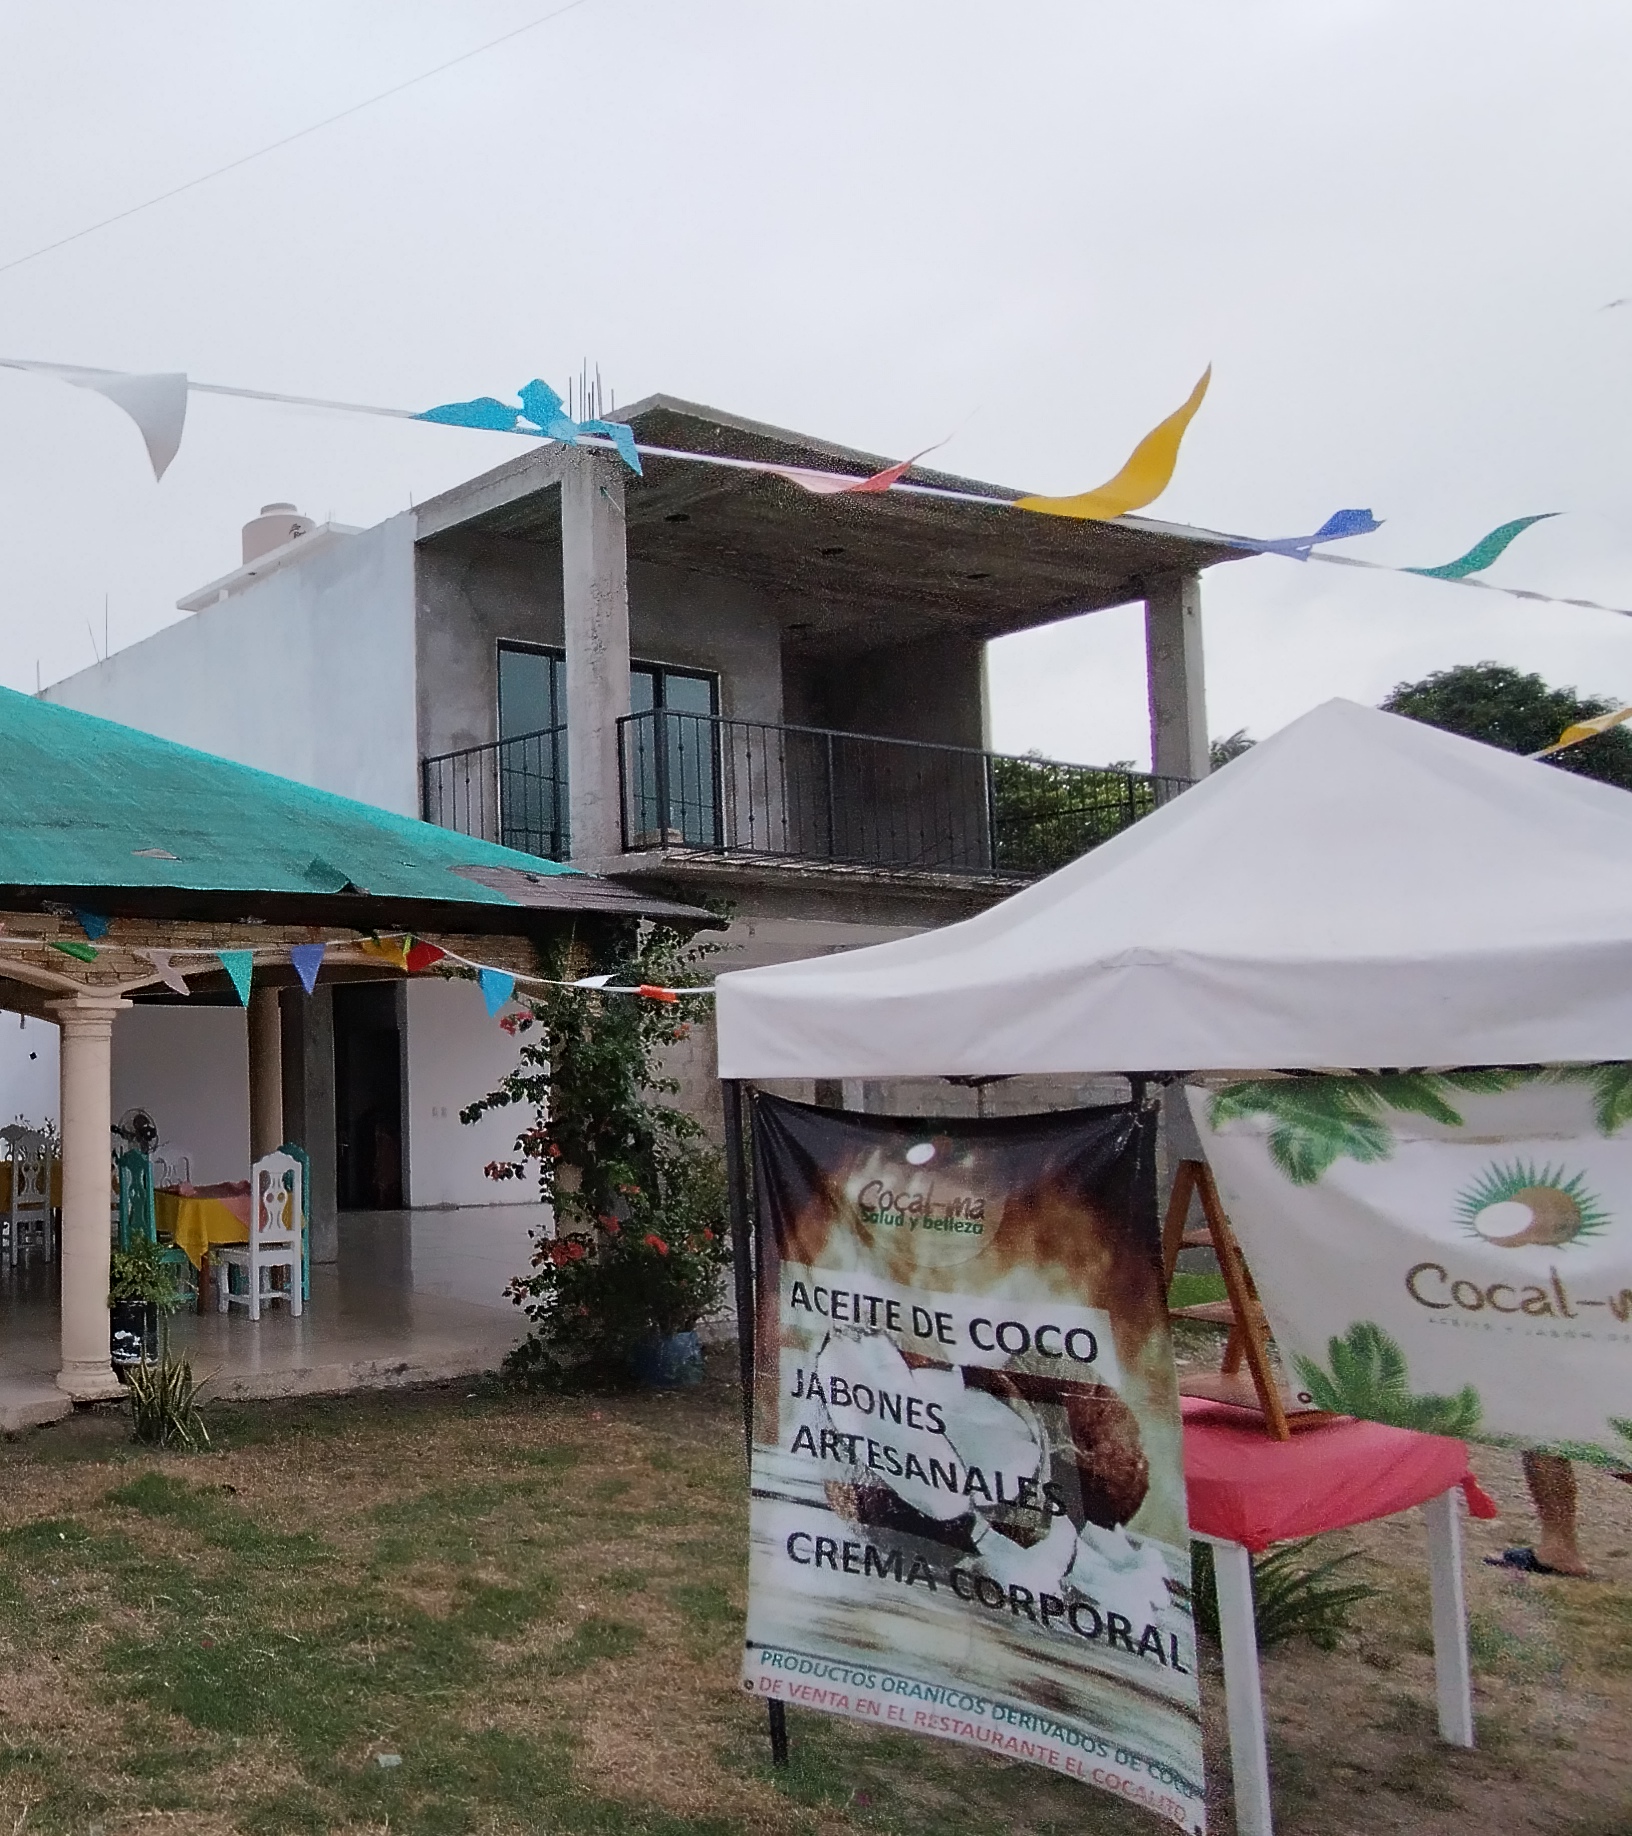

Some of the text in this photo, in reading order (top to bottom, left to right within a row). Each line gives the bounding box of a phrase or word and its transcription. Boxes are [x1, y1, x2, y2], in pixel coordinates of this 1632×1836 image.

[857, 1179, 986, 1220] Cocal-ma
[908, 1216, 918, 1232] y
[923, 1215, 984, 1235] belleza
[790, 1280, 1098, 1364] ACEITE DE COCO
[790, 1368, 948, 1435] JABONES
[790, 1424, 1068, 1517] ARTESANALES
[786, 1531, 1190, 1675] CREMA CORPORAL
[759, 1676, 784, 1693] DE
[788, 1682, 850, 1711] VENTA
[856, 1698, 881, 1717] EN
[887, 1705, 908, 1723] EL
[914, 1711, 1060, 1768] RESTAURANTE
[1064, 1756, 1086, 1777] EL
[760, 1650, 877, 1690] PRODUCTOS
[881, 1676, 987, 1716] ORANICOS
[991, 1701, 1108, 1759] DERIVADOS
[1114, 1748, 1142, 1772] DE
